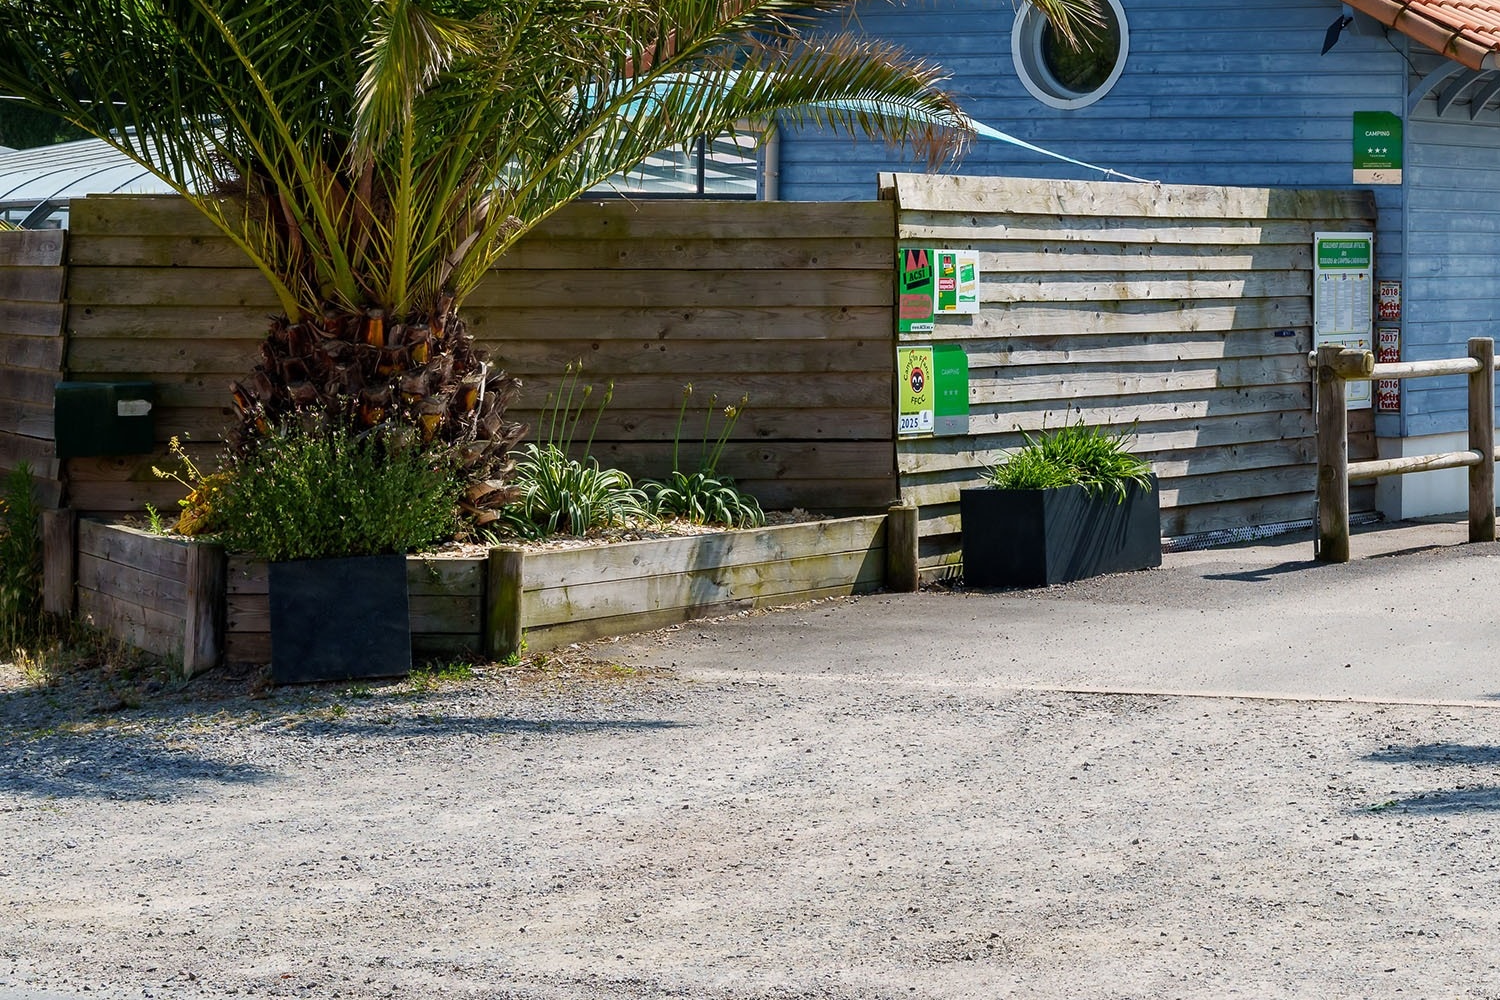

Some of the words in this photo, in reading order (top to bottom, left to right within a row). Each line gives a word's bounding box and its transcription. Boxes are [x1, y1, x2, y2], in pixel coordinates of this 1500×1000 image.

[909, 268, 925, 281] ACSI
[911, 394, 926, 405] FFCC
[901, 418, 918, 428] 2025
